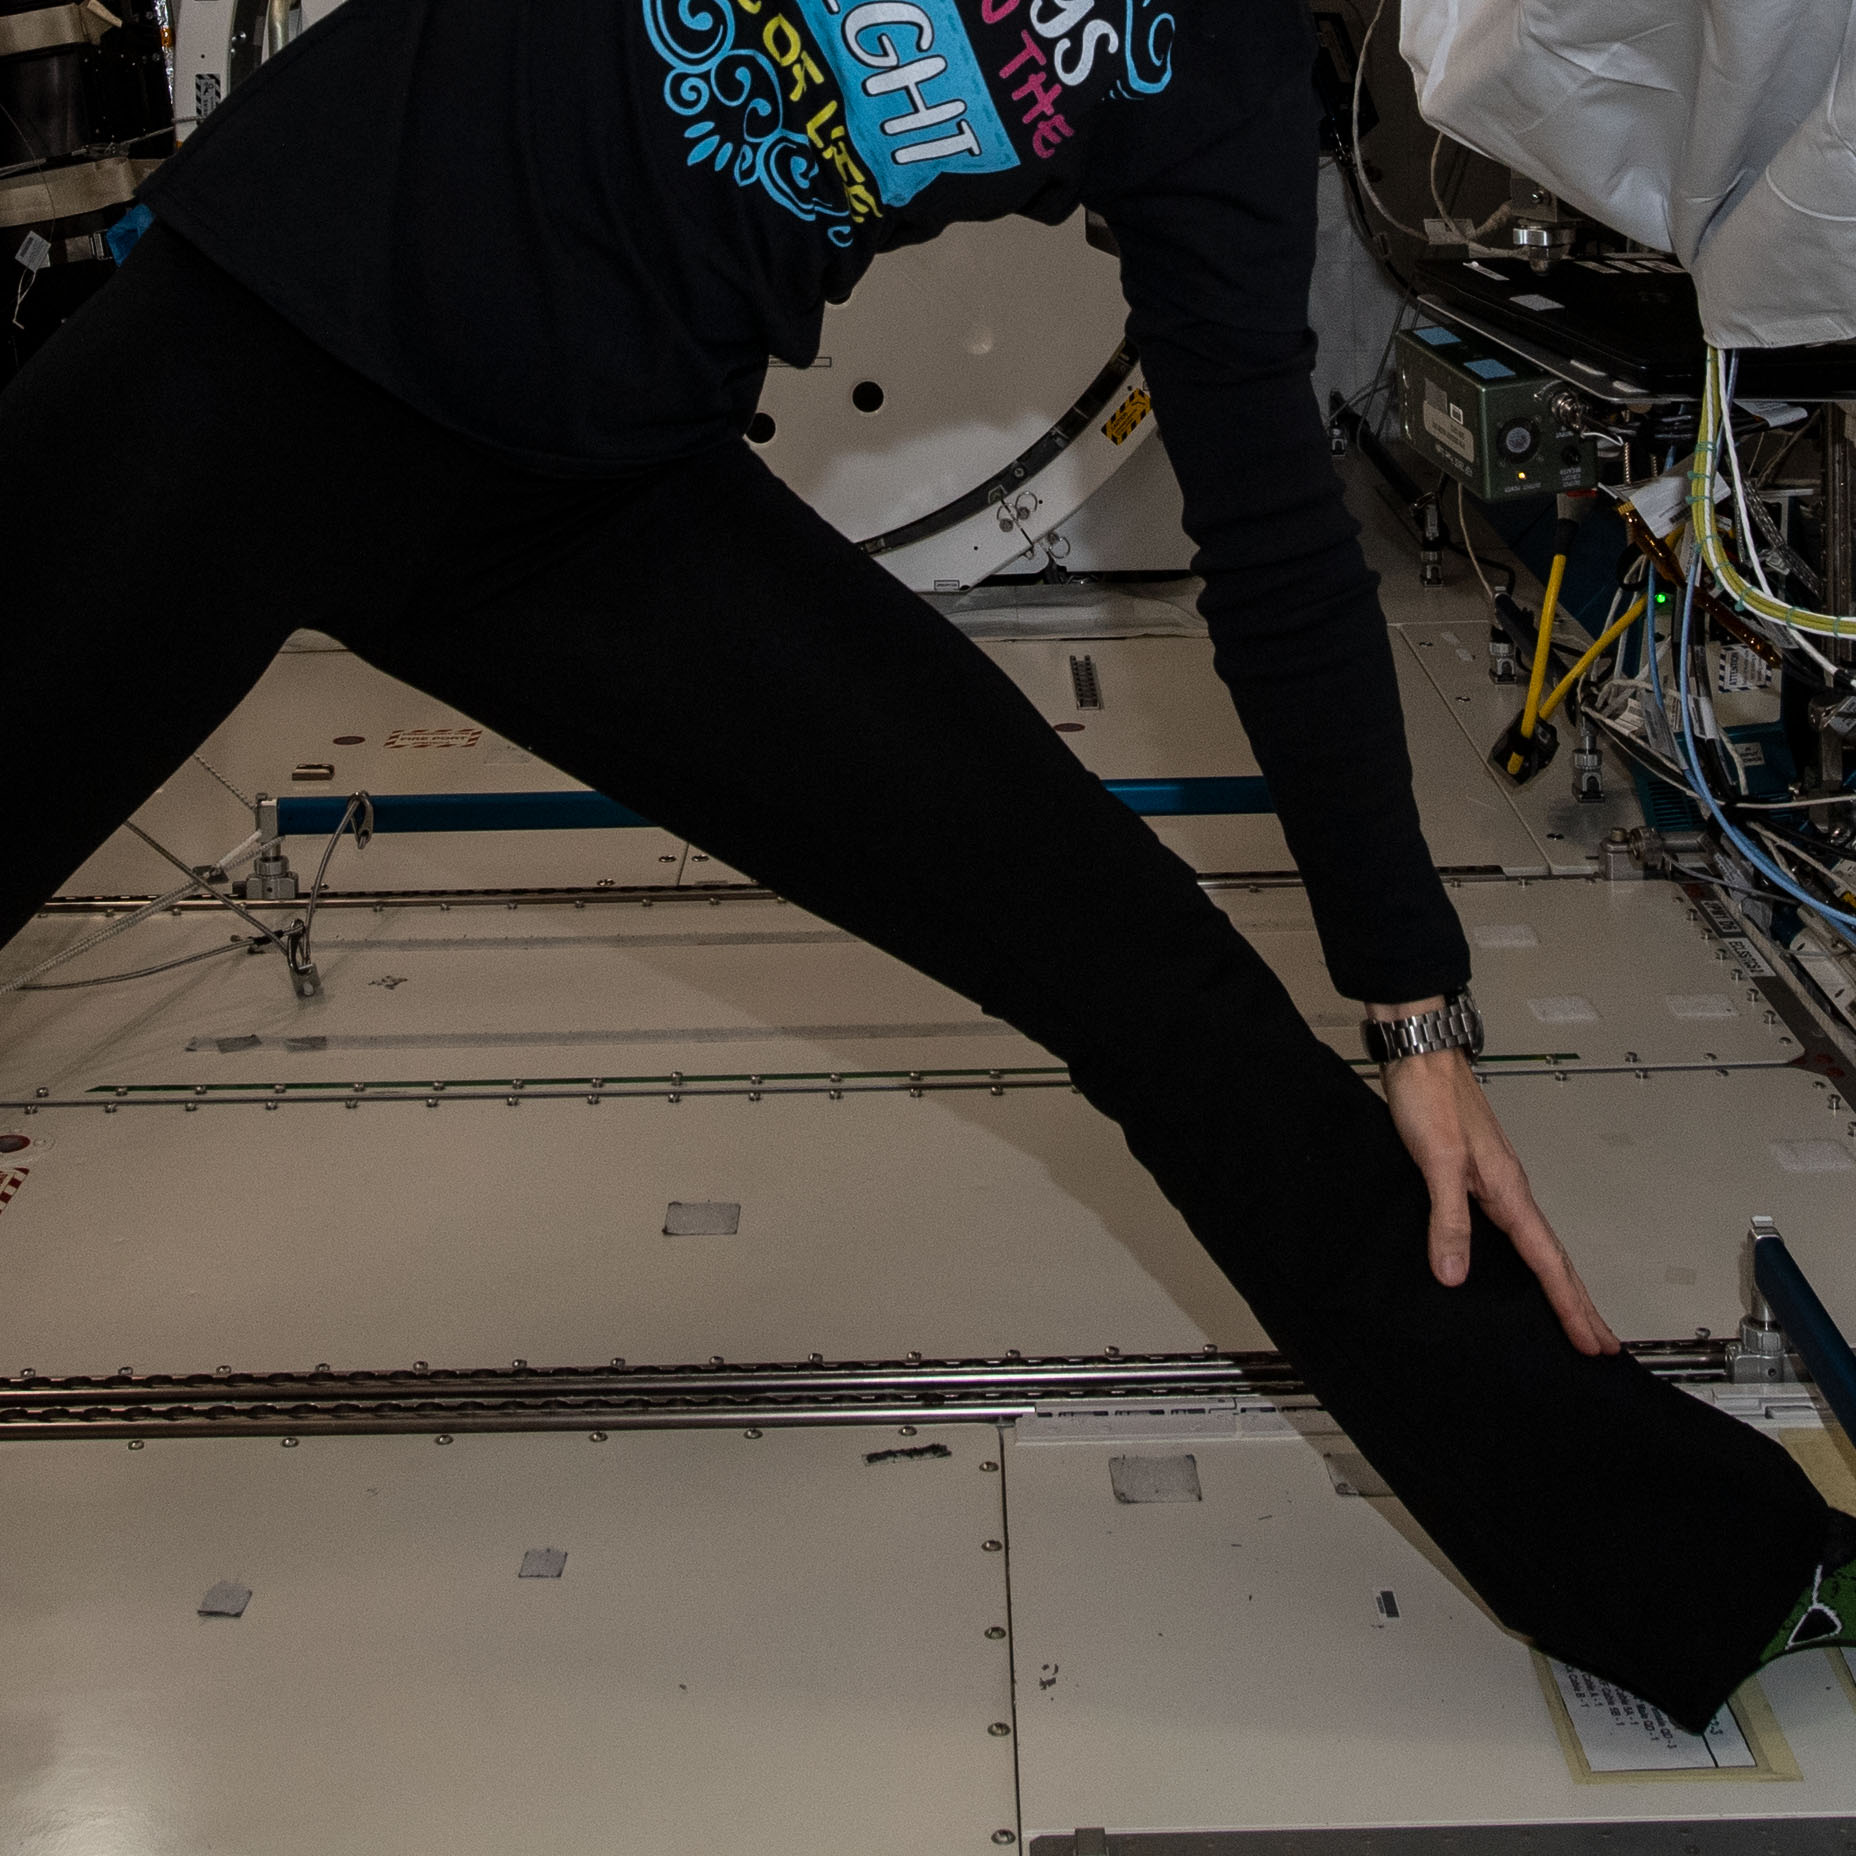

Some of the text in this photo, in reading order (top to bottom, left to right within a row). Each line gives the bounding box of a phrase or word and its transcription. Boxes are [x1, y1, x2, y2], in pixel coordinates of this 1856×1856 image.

[762, 12, 825, 102] OF
[805, 99, 884, 224] LIFE
[999, 30, 1075, 159] THE
[1727, 649, 1739, 685] ATTENTION
